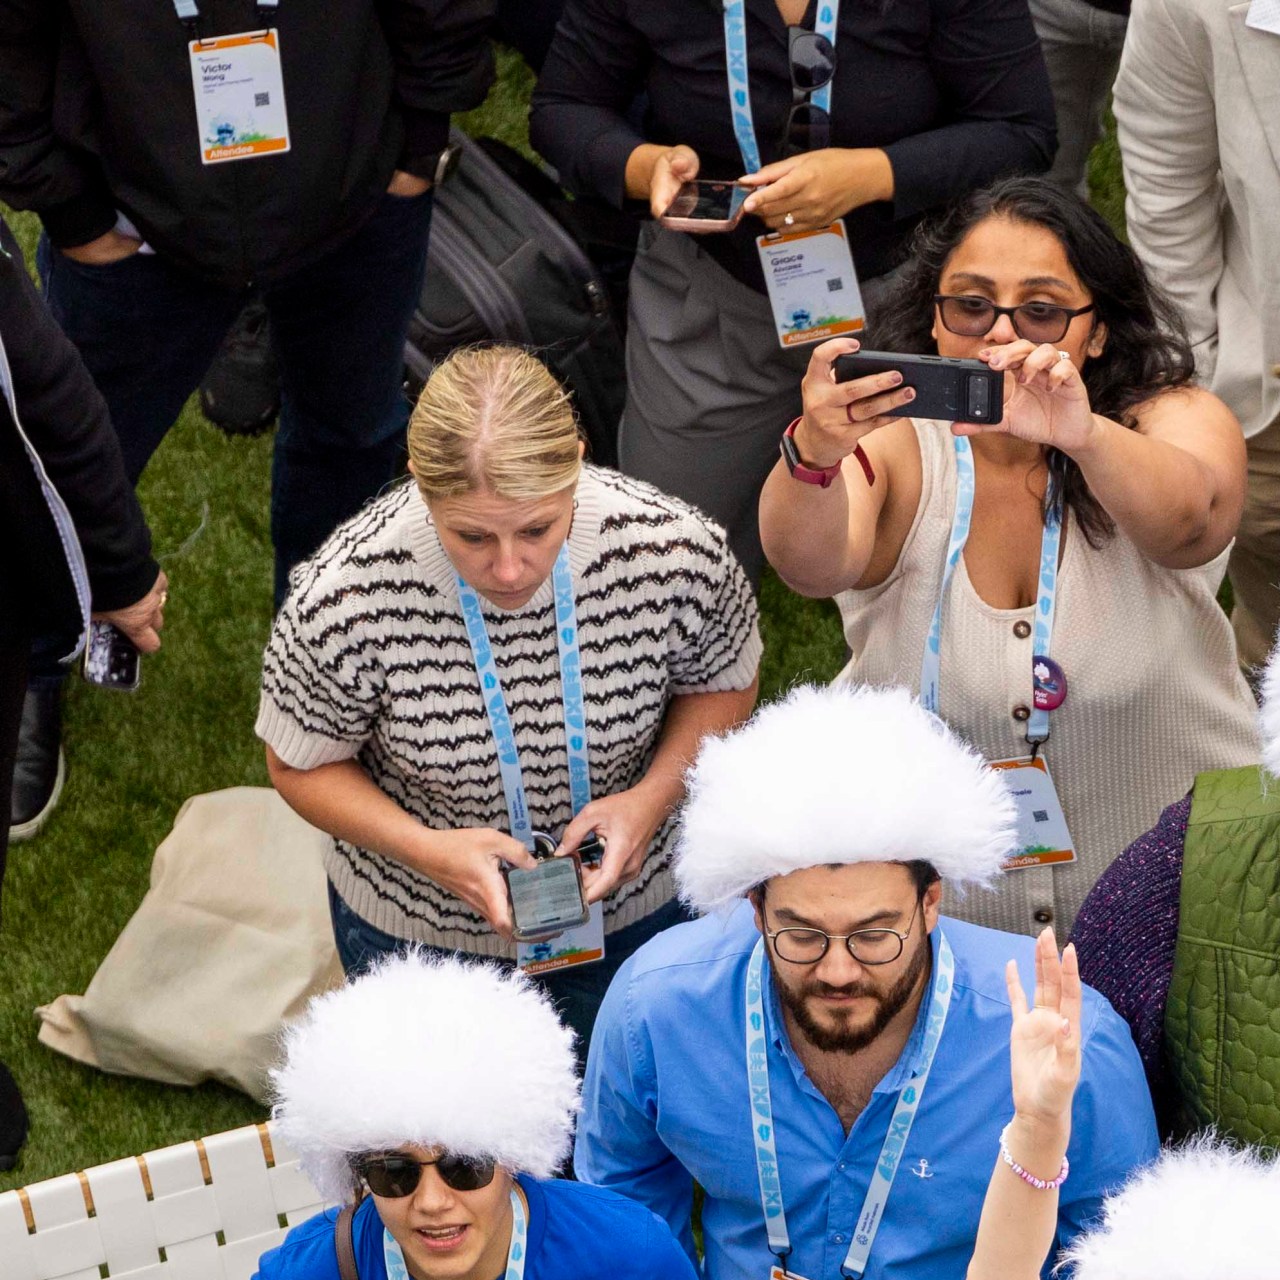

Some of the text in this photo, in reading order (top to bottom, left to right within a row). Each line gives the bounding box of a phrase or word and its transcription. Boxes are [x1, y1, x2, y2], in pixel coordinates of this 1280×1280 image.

[202, 63, 232, 74] Victor
[210, 145, 254, 159] Attendee
[771, 254, 804, 266] Grace
[788, 328, 831, 343] Attendee
